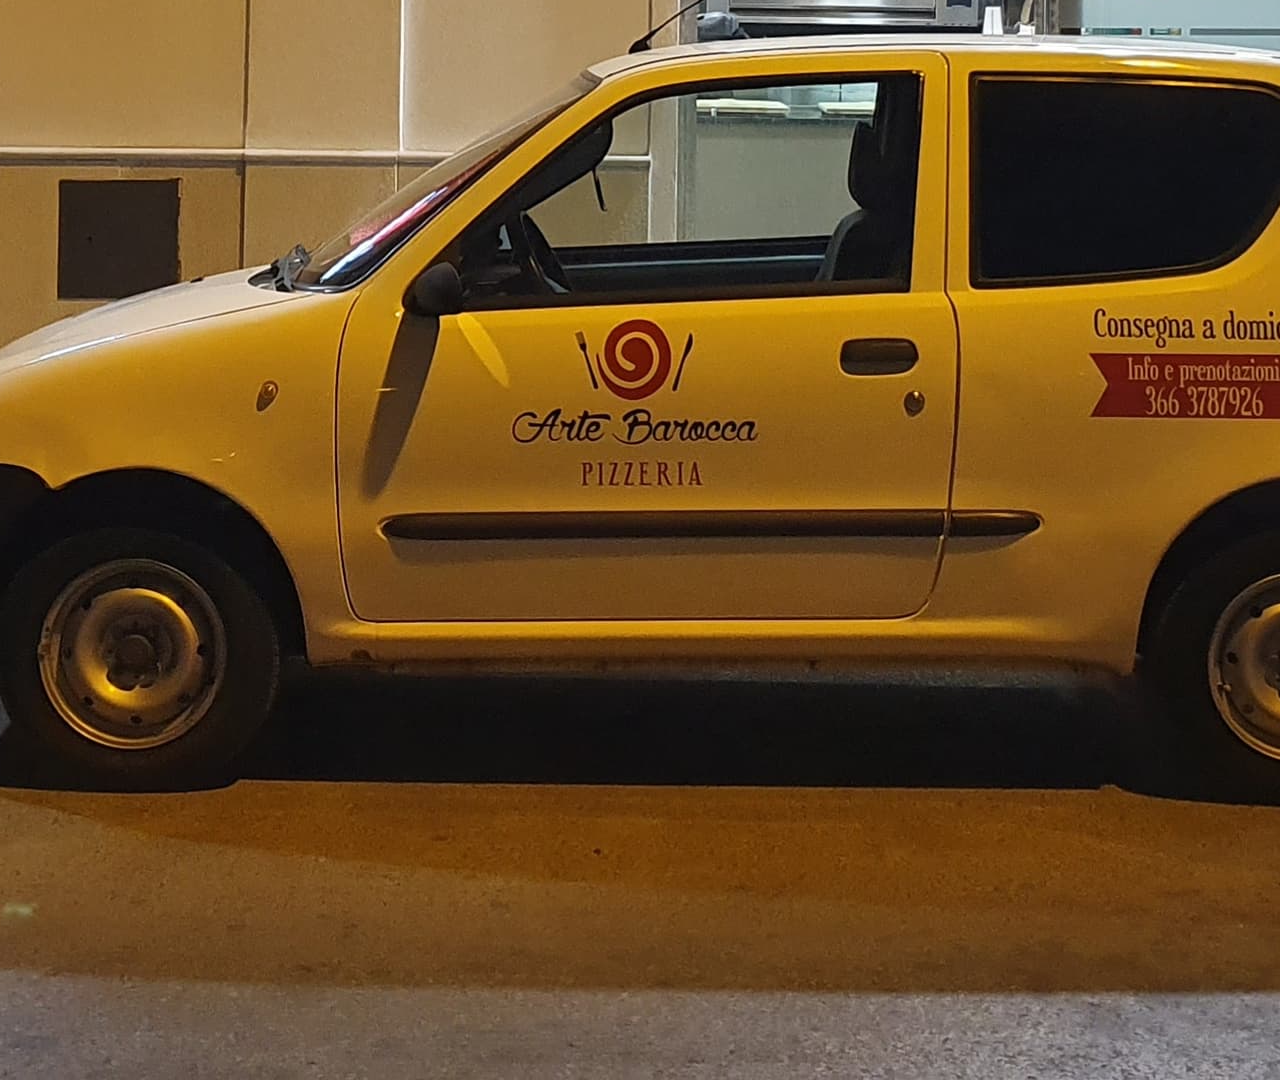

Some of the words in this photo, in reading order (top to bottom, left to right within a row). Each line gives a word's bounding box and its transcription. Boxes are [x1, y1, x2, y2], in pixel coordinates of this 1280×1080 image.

[1093, 308, 1196, 349] Consegna
[1202, 318, 1216, 340] a
[1127, 355, 1159, 381] Info
[1164, 366, 1174, 381] e
[1179, 358, 1280, 388] prenotazioni
[1145, 385, 1180, 416] 366
[1186, 386, 1264, 417] 3787926
[511, 407, 612, 444] Arte
[612, 408, 759, 446] Barocca
[581, 461, 704, 486] PIZZERIA
